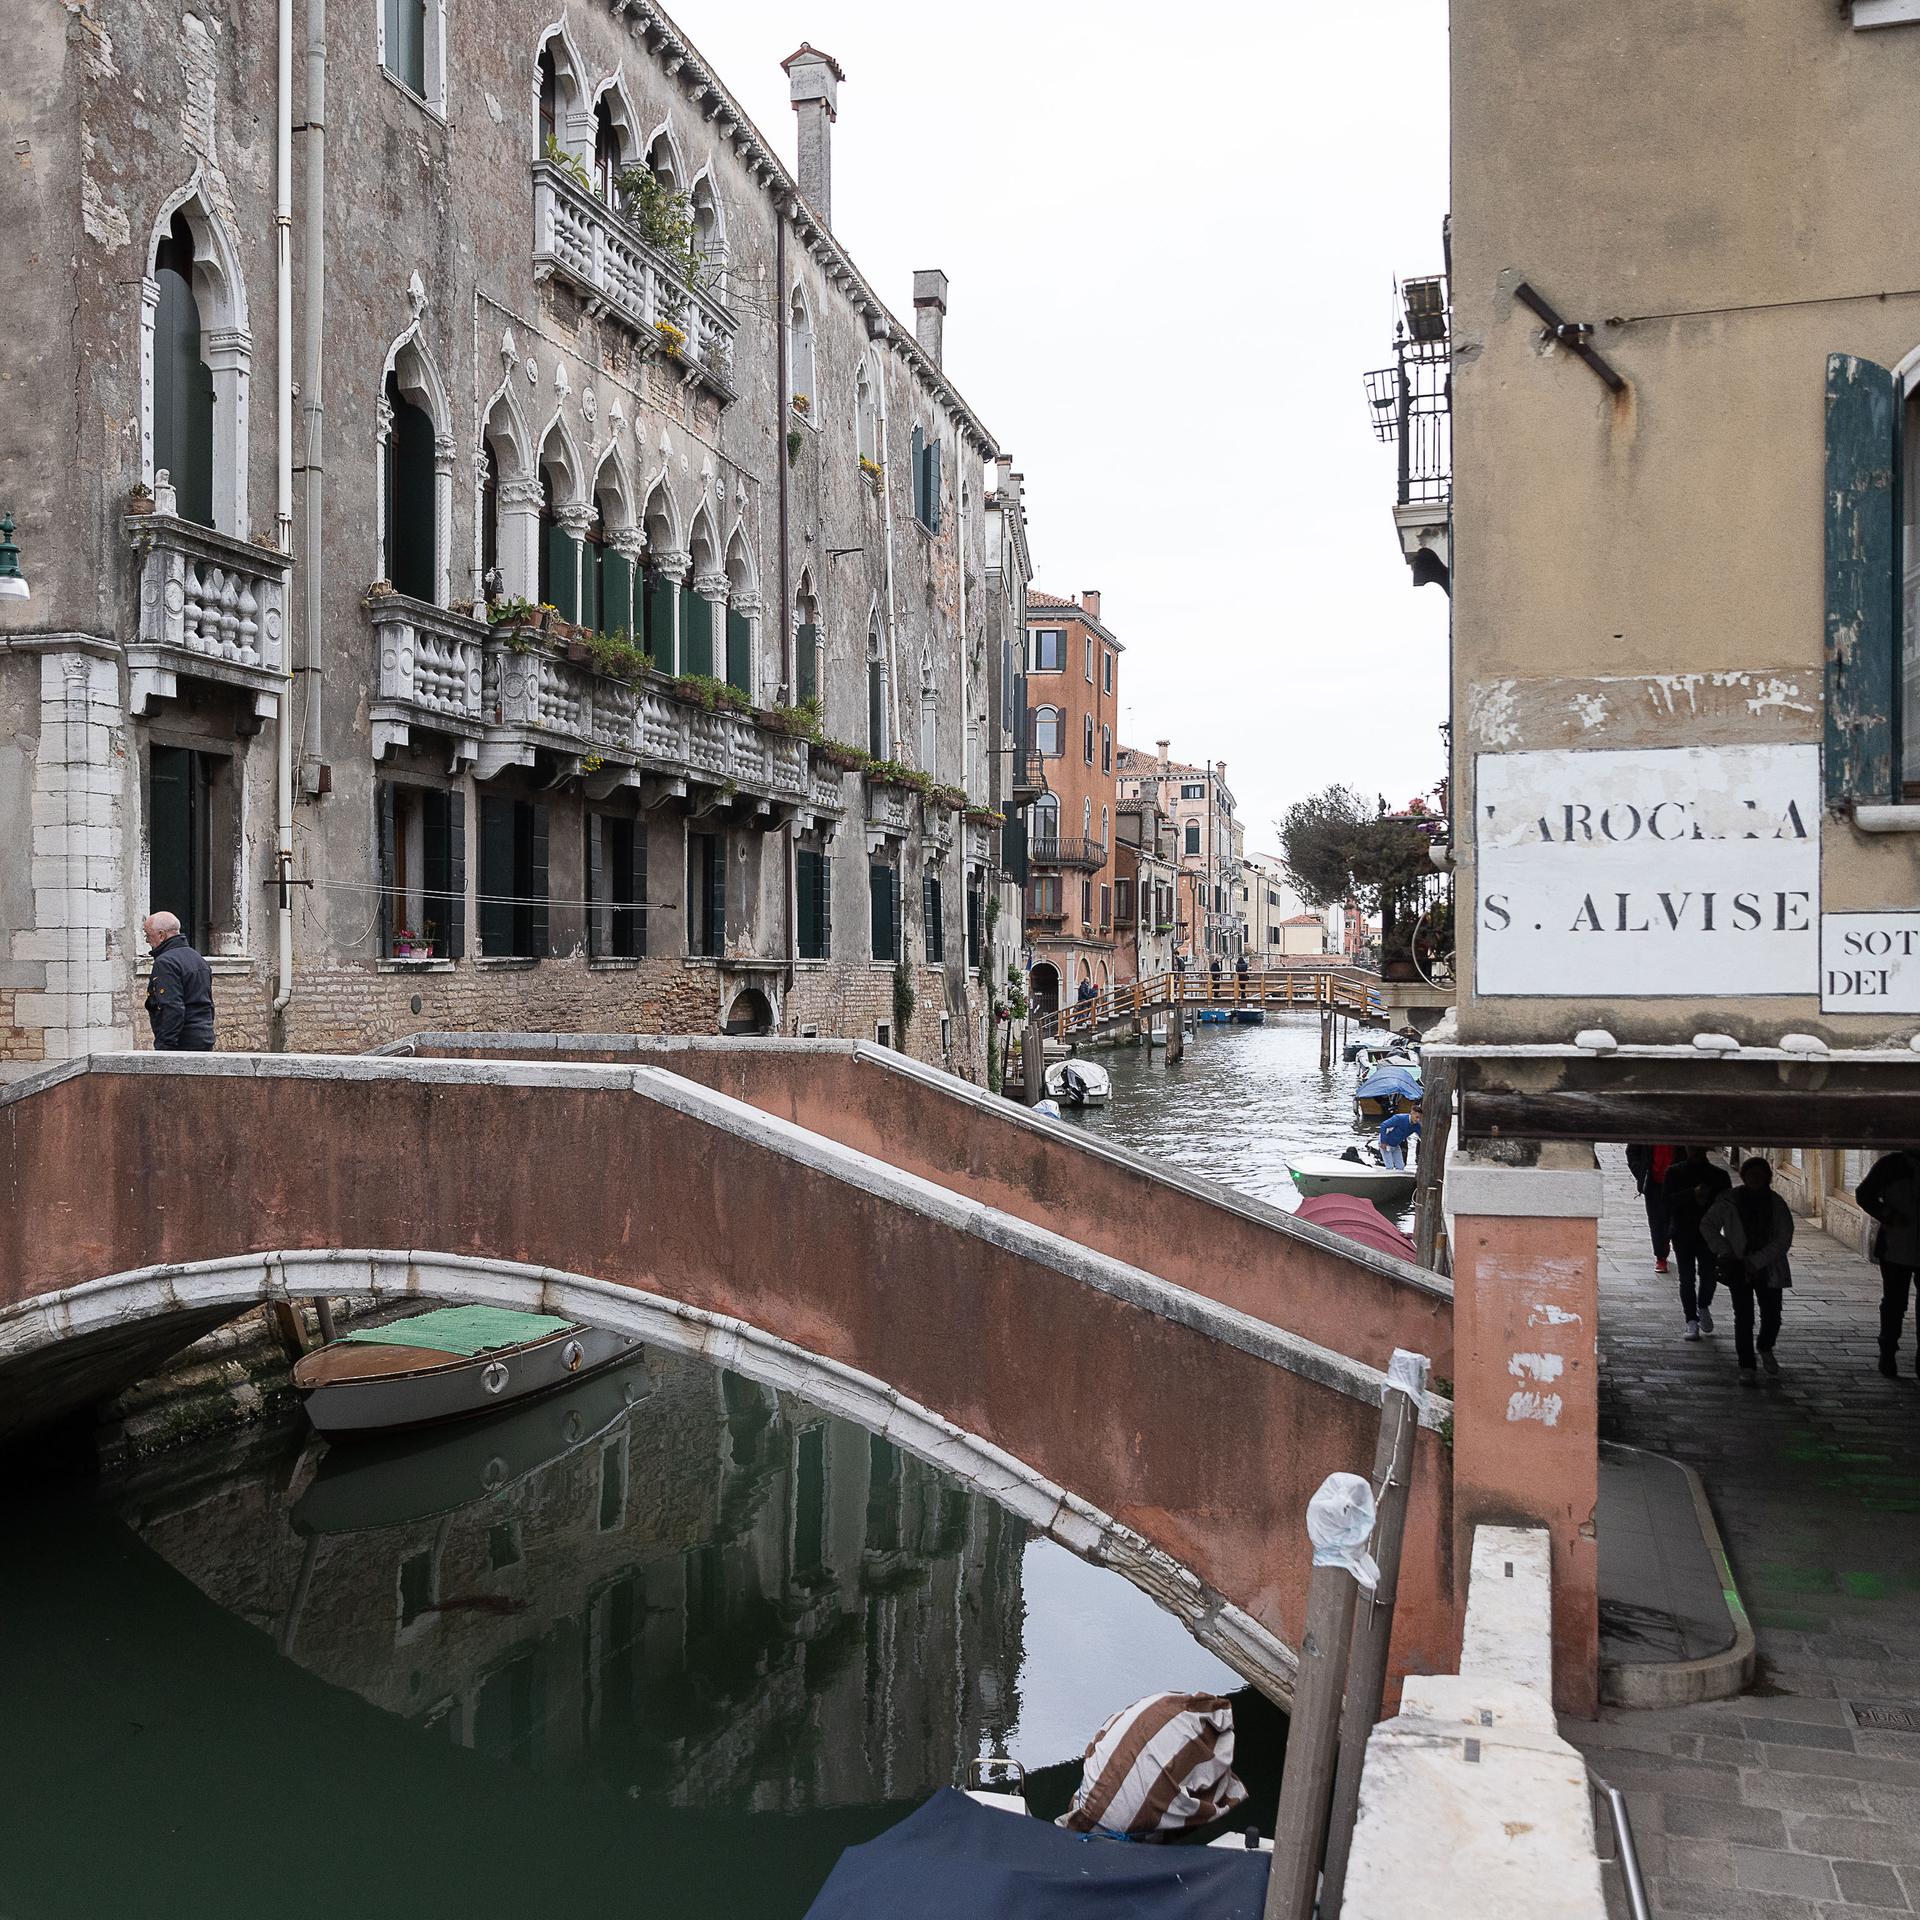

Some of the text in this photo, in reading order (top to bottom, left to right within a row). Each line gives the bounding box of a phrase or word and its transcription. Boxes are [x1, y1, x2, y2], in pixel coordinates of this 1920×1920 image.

[1568, 891, 1810, 932] ALVISE
[1844, 929, 1919, 956] SOT
[1827, 969, 1889, 996] DEI
